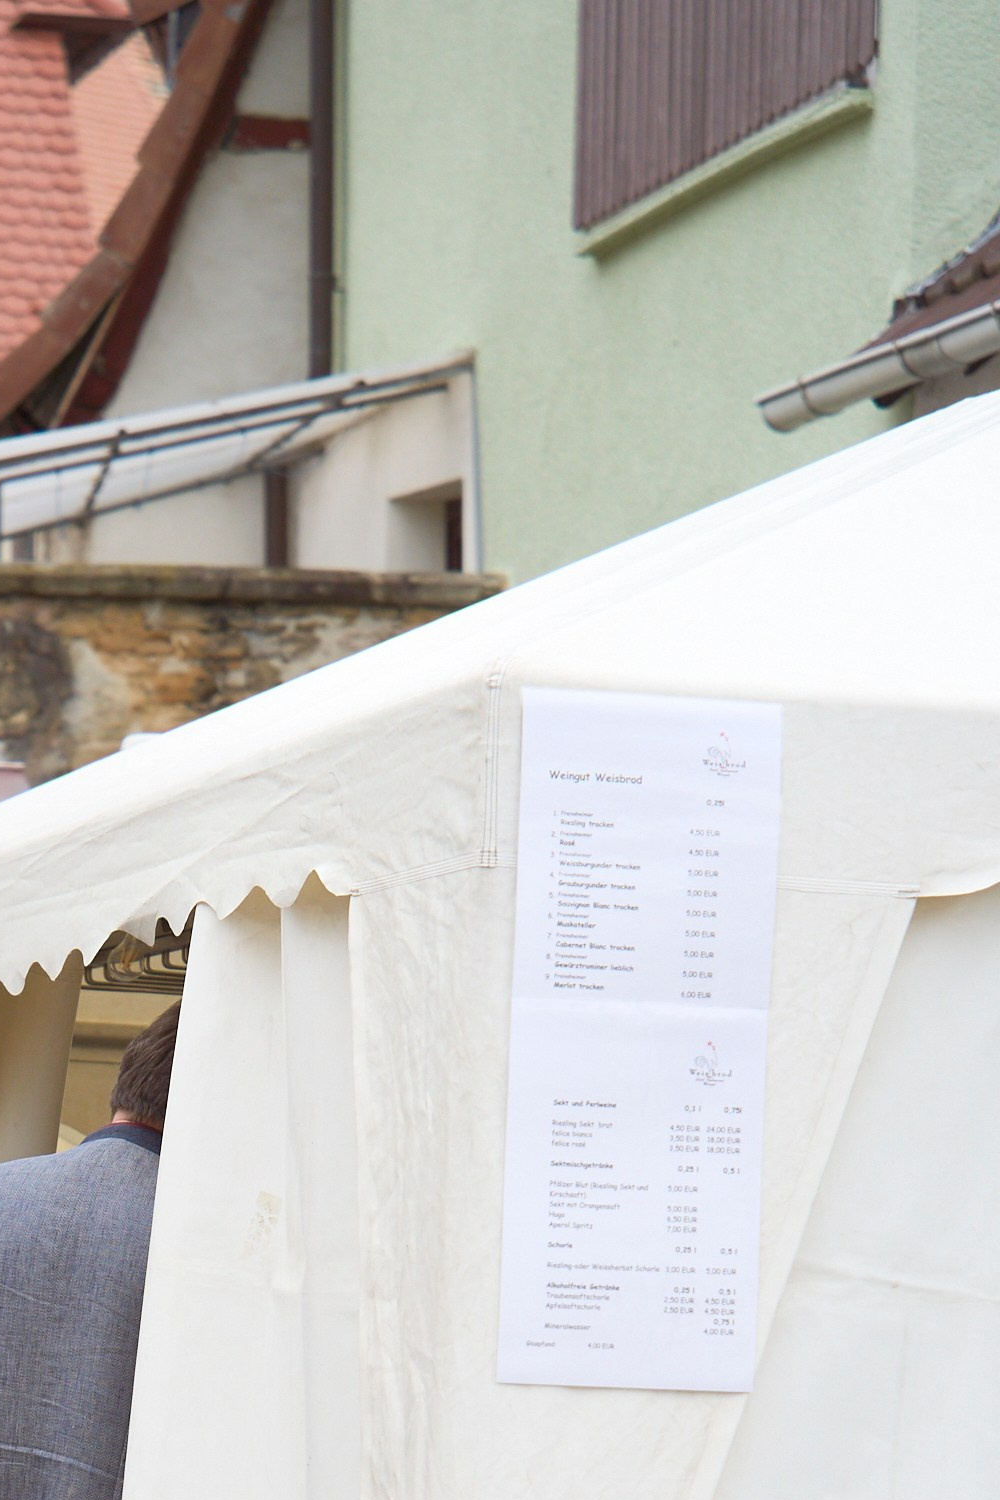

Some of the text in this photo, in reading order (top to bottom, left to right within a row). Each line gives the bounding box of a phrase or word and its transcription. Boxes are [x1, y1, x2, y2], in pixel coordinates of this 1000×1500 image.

[549, 770, 643, 784] Weingut Weisbrod
[560, 819, 586, 828] Riesling
[559, 860, 641, 870] Weissburgunder trocken
[558, 880, 607, 889] Grauburgunder
[557, 901, 590, 910] Sauvignon
[613, 903, 639, 911] trocken
[557, 921, 596, 929] Muskateller
[556, 941, 586, 949] Cabernet
[555, 961, 634, 972] Gewürztraminer lieblich
[579, 983, 604, 991] trocken
[552, 1120, 577, 1128] Riesling
[550, 1160, 613, 1170] Sektmischgetränke
[590, 1182, 618, 1192] (Riesling
[580, 1202, 620, 1211] Orangensaft
[549, 1211, 565, 1219] Hugo
[548, 1222, 570, 1230] Aperol
[635, 1265, 660, 1273] Schorle
[546, 1282, 586, 1290] Alkoholfreie
[547, 1292, 610, 1301] Traubensaftschorle
[545, 1302, 601, 1311] Apfelsaftschorle
[544, 1323, 591, 1331] Mineralwasser
